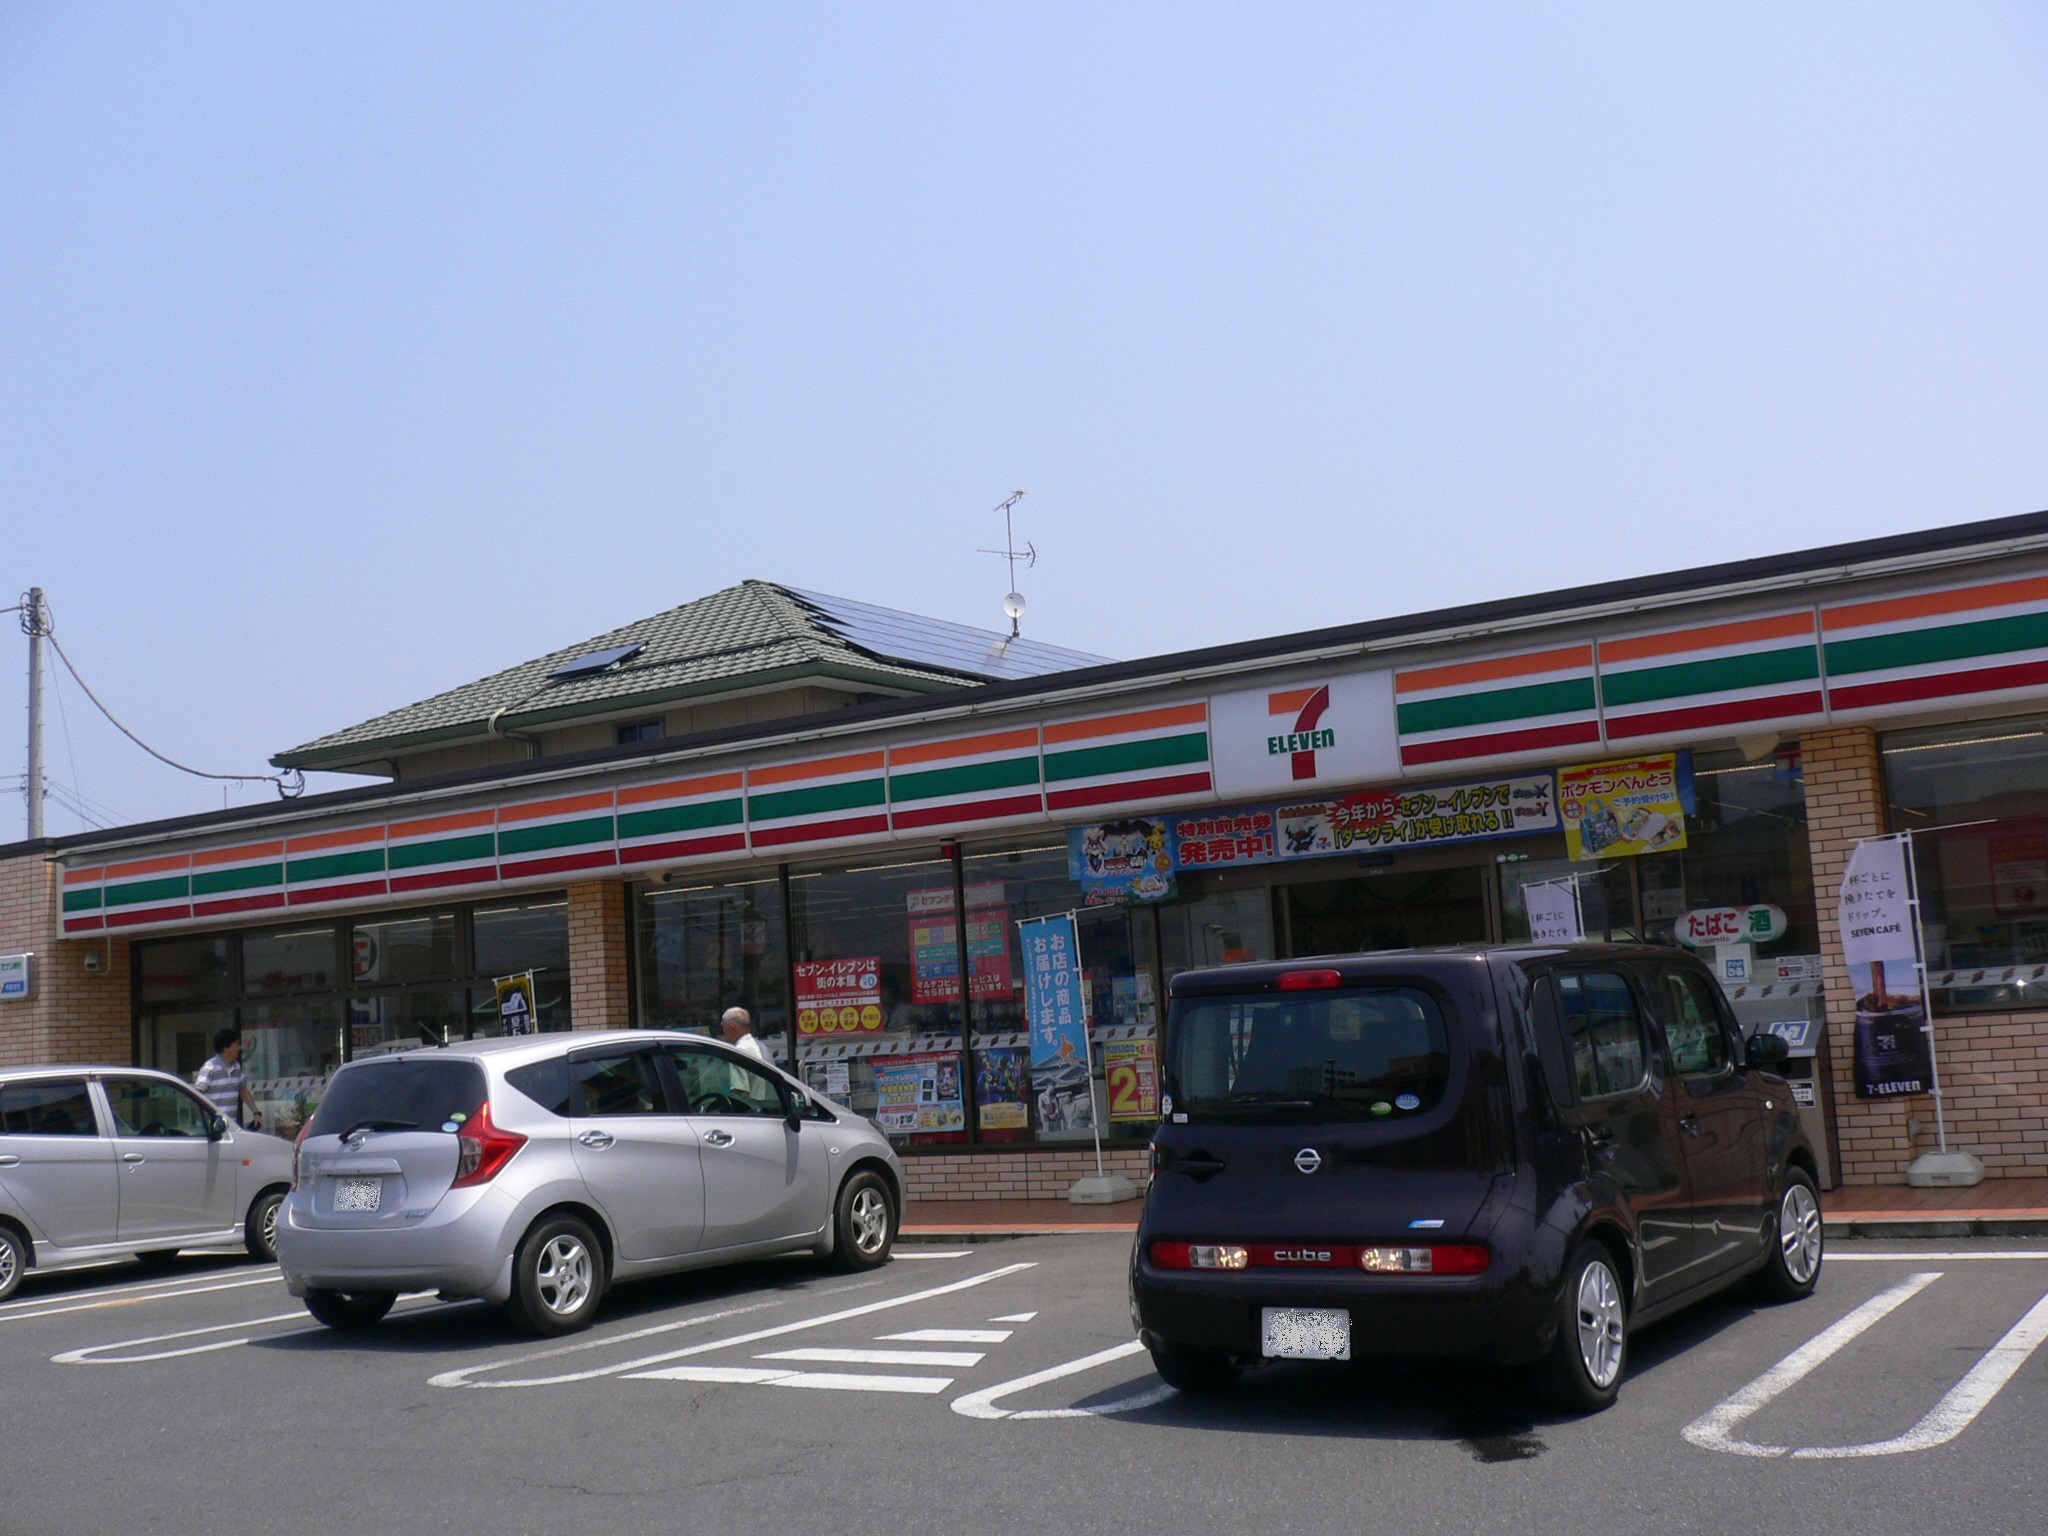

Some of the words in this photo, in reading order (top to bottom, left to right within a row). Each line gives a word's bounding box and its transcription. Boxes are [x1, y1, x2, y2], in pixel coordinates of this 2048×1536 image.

[1268, 684, 1330, 780] 7
[1561, 771, 1673, 798] ポケモンべんとう
[1336, 797, 1396, 826] 今年から
[1176, 812, 1272, 838] 特別前売券
[1178, 833, 1275, 865] 発売中!
[1687, 912, 1740, 937] たばこ
[1747, 909, 1772, 933] 酒
[1850, 926, 1875, 938] SEVEN
[796, 960, 877, 977] セブン-イレブンは
[816, 974, 857, 989] 街の本屋
[1050, 933, 1072, 1026] お店の商品
[1034, 936, 1059, 1047] お届けします。
[1111, 1066, 1139, 1111] 2
[1273, 1249, 1332, 1262] cube
